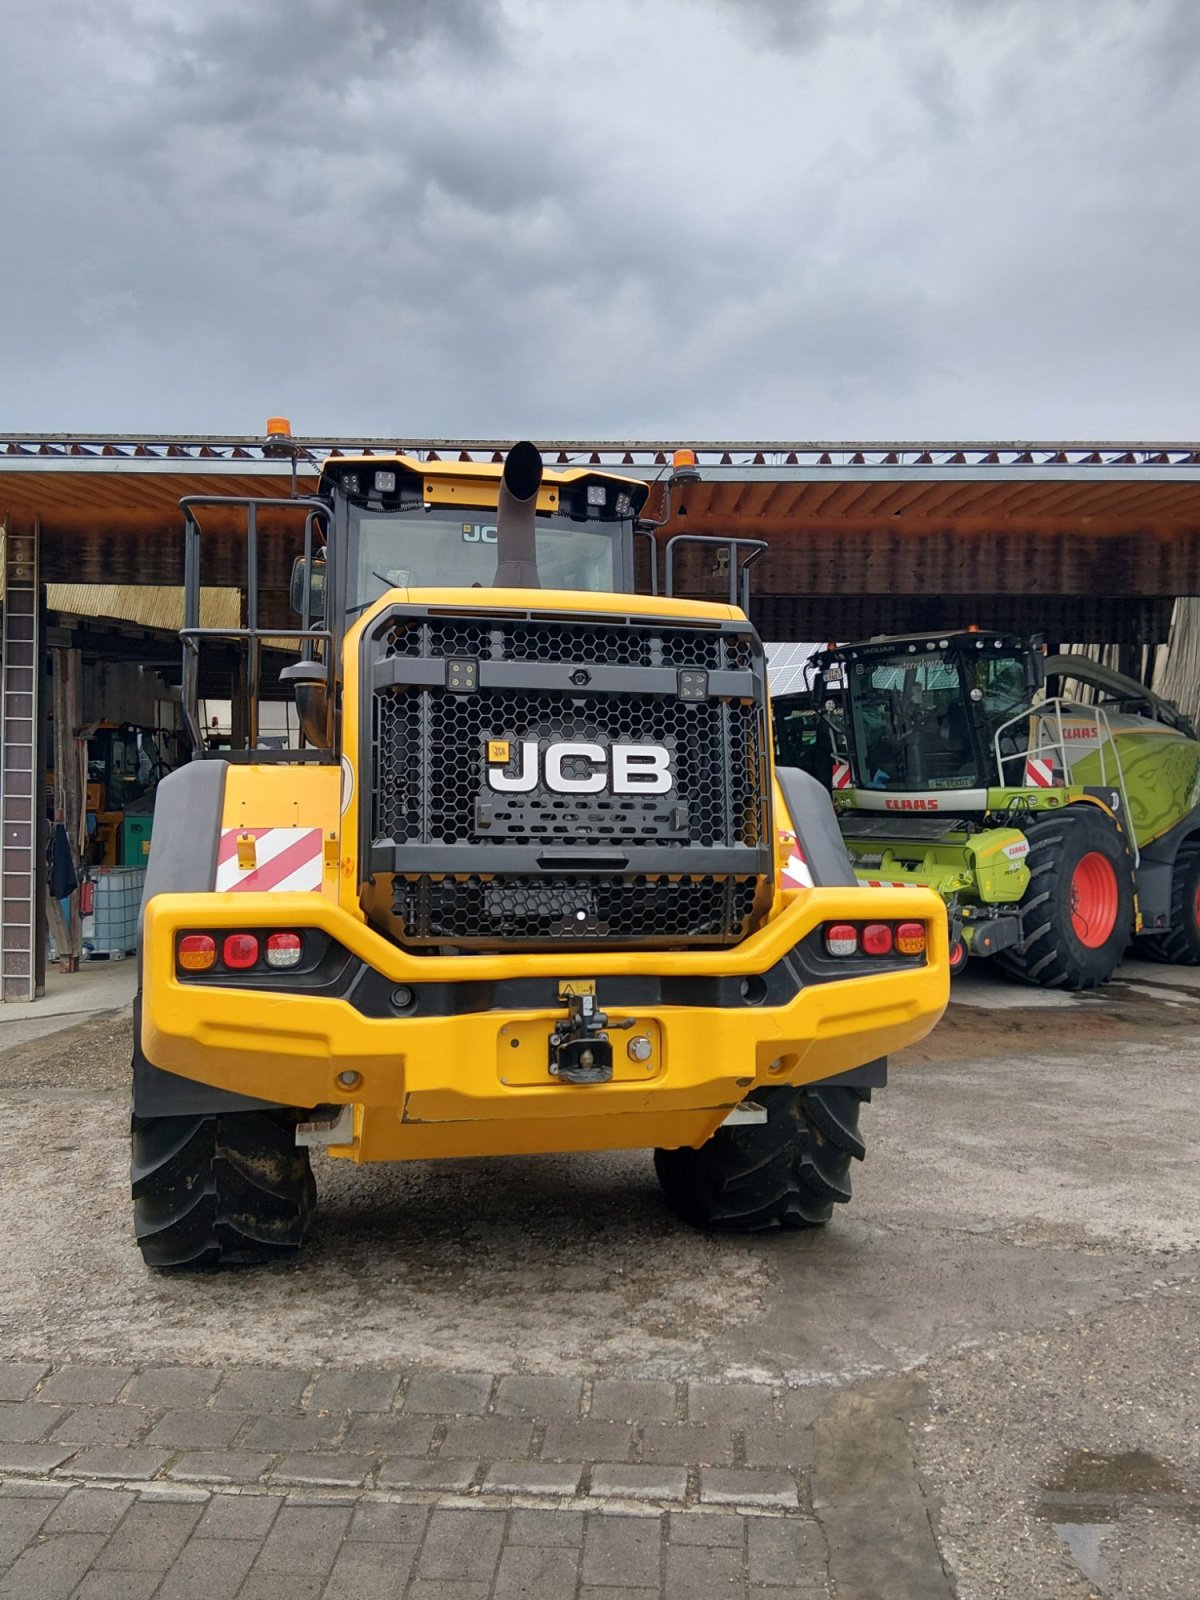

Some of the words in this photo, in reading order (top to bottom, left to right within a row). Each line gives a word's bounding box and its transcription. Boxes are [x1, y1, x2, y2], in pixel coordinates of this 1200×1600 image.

[463, 524, 498, 543] JC
[1062, 727, 1098, 739] CLAAS
[488, 742, 673, 793] JCB
[885, 799, 938, 810] CLAAS
[1009, 844, 1026, 855] CLAAS
